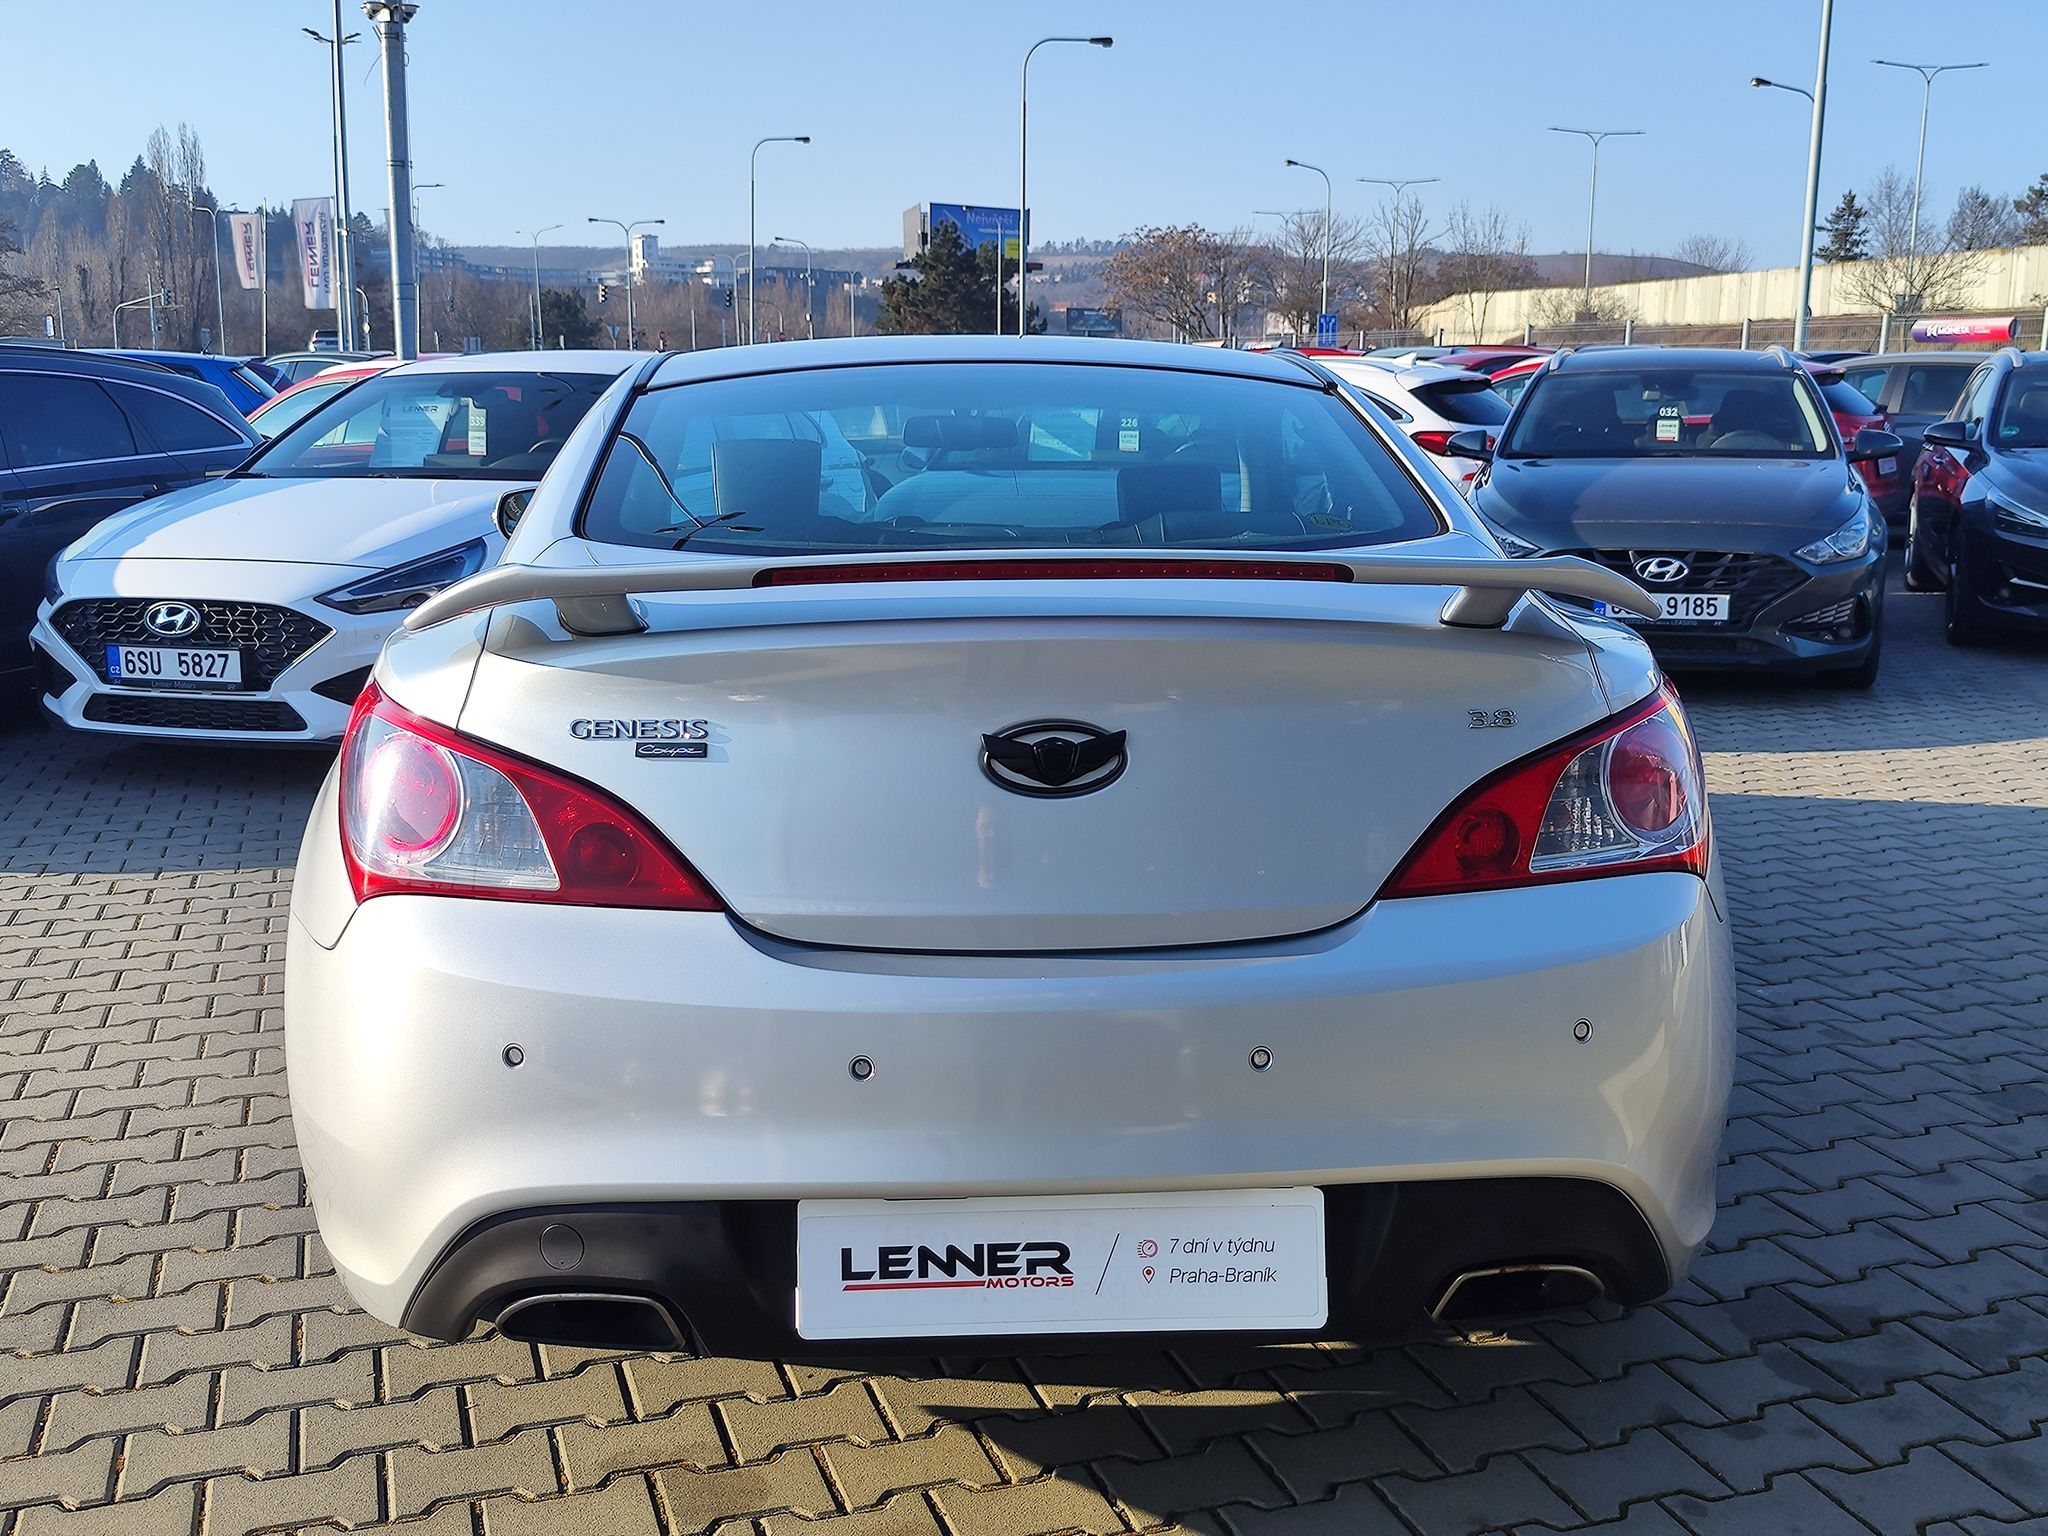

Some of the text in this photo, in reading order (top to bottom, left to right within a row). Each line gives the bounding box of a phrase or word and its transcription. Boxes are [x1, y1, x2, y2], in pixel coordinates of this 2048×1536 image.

[1659, 407, 1679, 417] 032
[1120, 418, 1138, 428] 226
[1666, 596, 1719, 617] 9185
[110, 665, 120, 674] CZ
[124, 650, 230, 679] 6SU 5827
[1467, 708, 1518, 729] 3.8
[568, 718, 709, 740] GENESIS
[637, 744, 703, 757] Coupe
[1170, 1237, 1275, 1257] 7 dní v týdnu
[841, 1241, 1074, 1281] LENNER
[986, 1276, 1075, 1289] MOTORS
[1169, 1266, 1277, 1283] Praha-Braník
